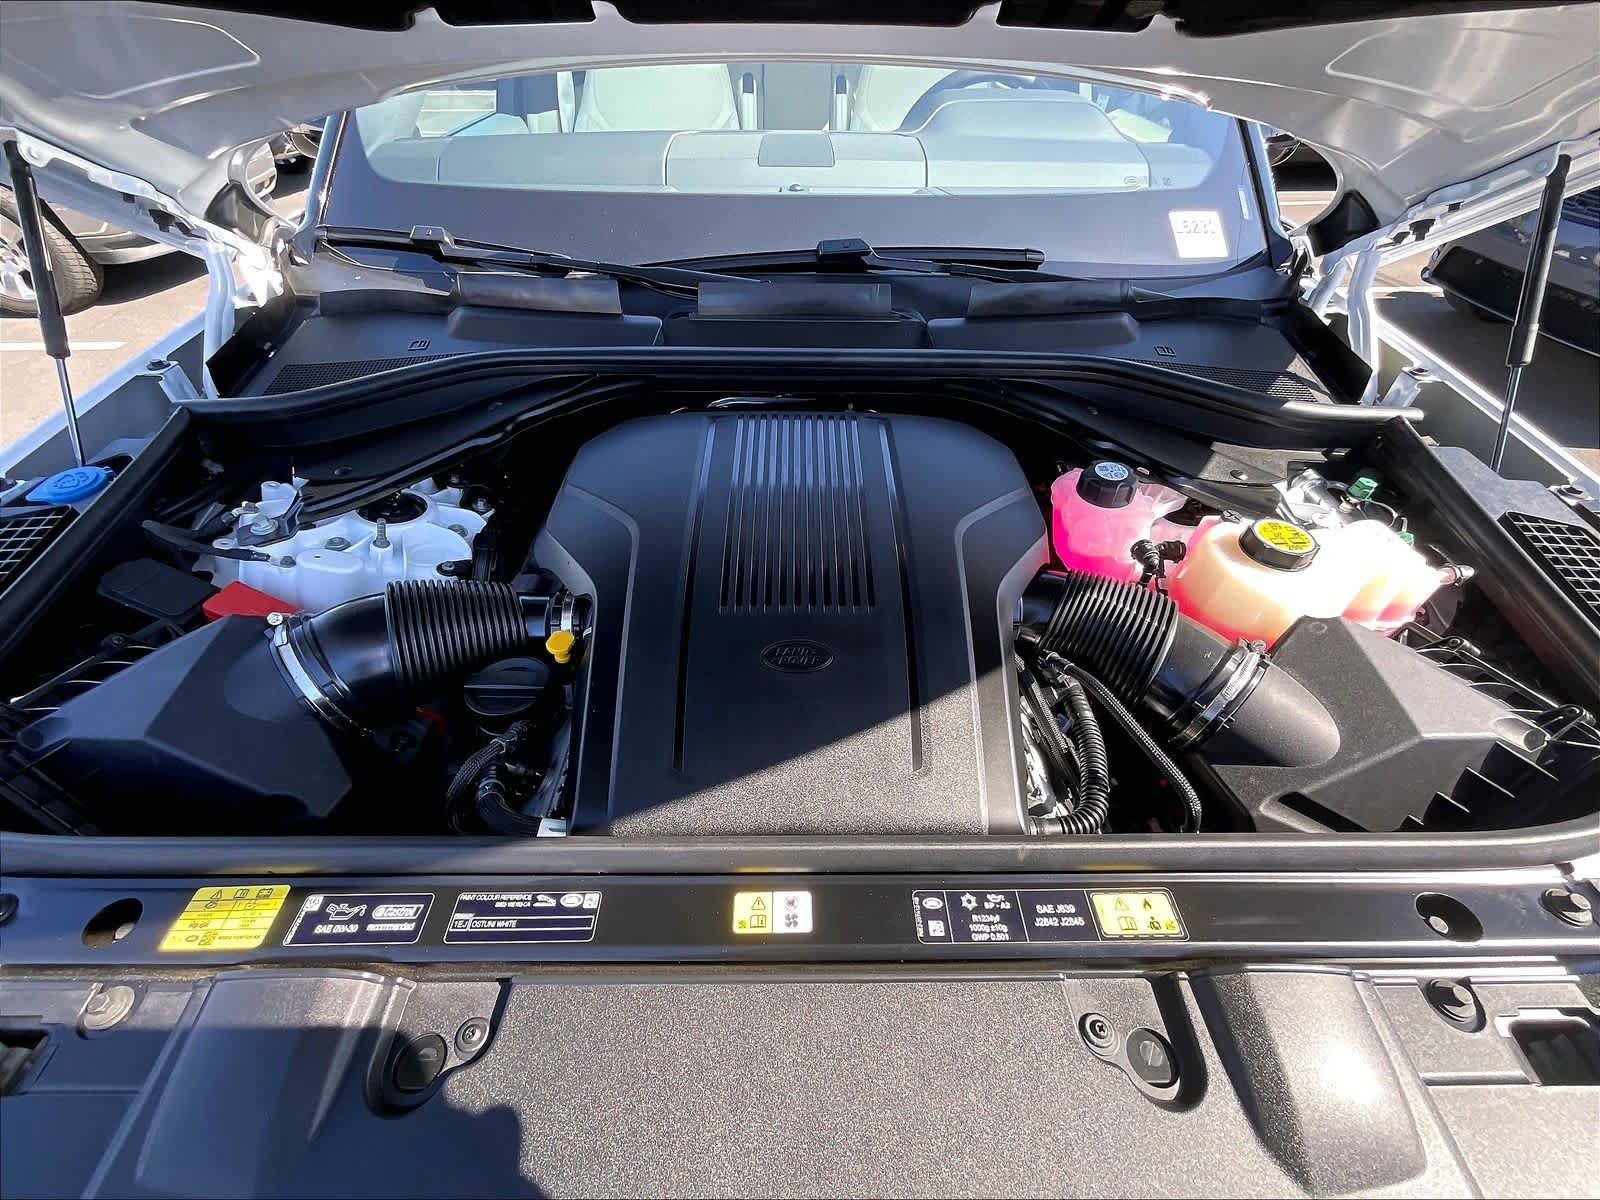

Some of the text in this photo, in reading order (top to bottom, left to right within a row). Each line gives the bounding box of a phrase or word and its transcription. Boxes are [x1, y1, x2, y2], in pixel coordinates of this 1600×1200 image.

[1036, 904, 1056, 914] SAE
[496, 919, 518, 928] WHITE
[314, 924, 334, 934] SAE
